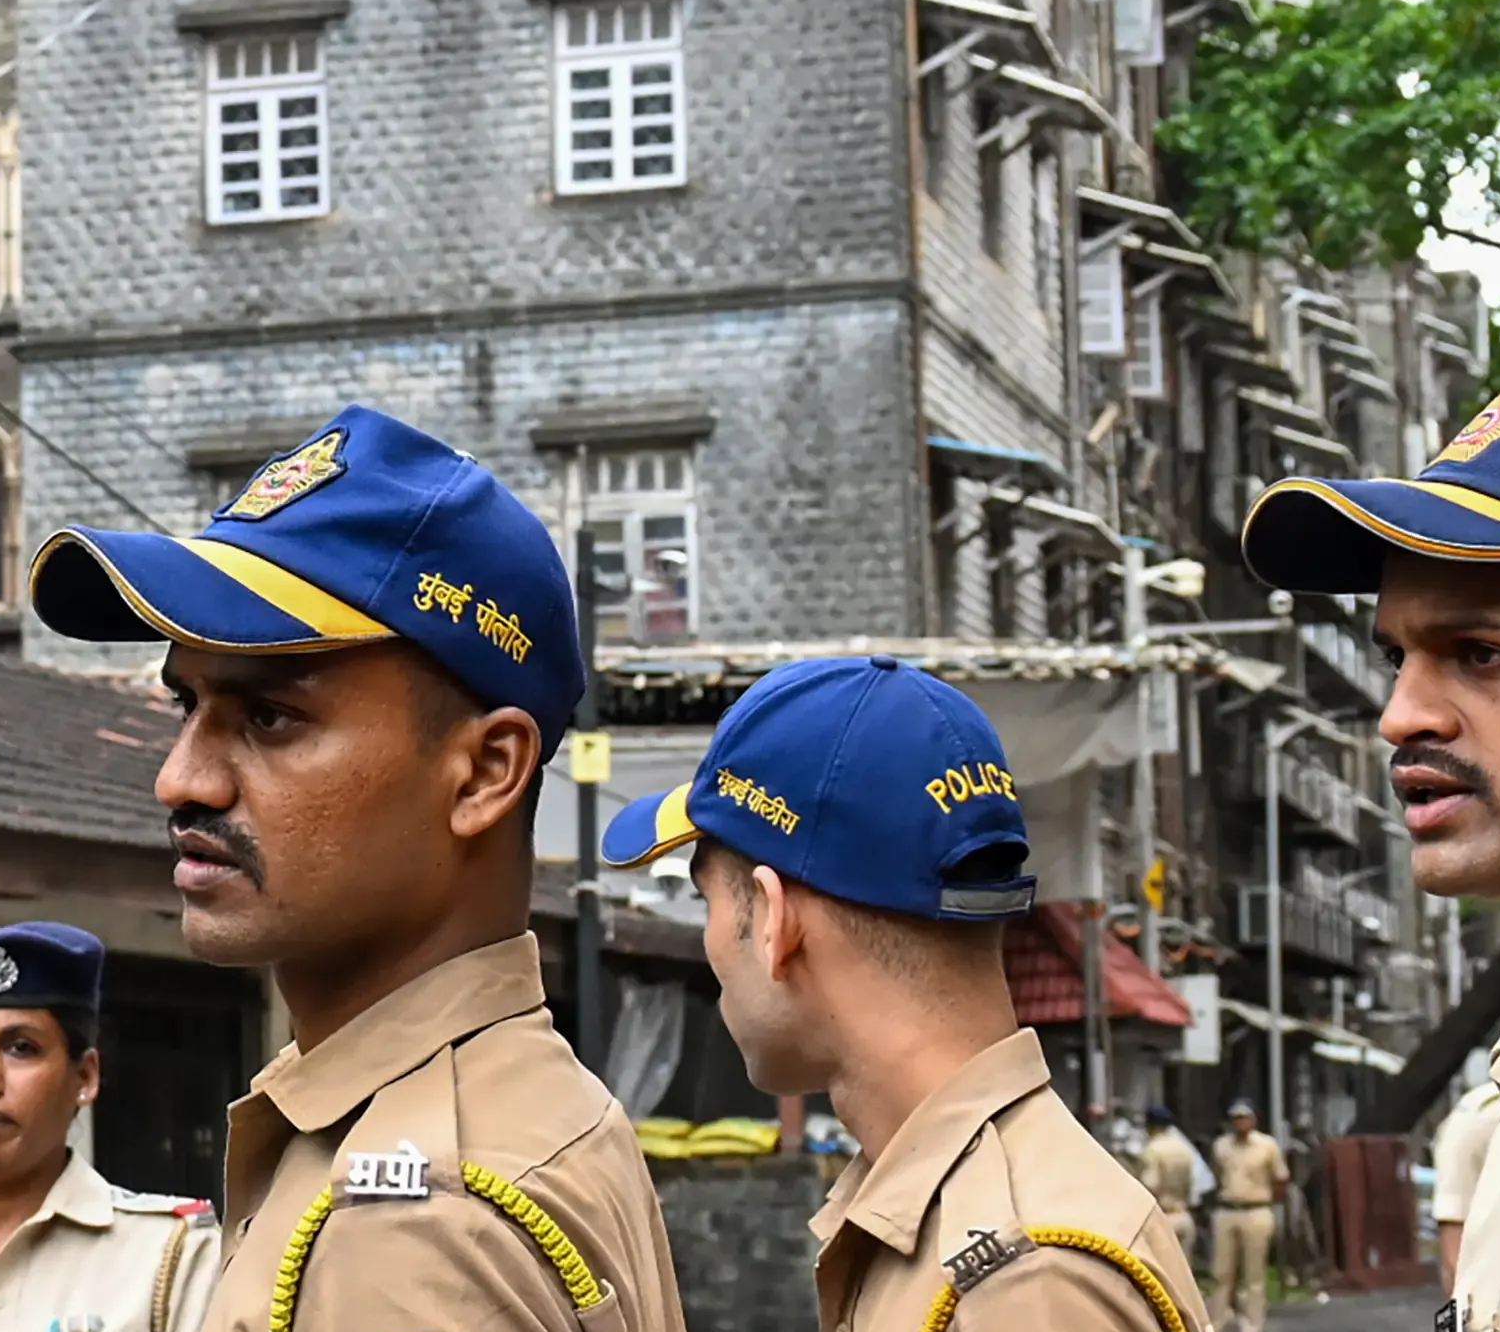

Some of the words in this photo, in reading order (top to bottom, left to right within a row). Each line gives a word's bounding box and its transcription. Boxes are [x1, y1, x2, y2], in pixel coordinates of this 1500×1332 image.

[413, 572, 474, 624] मुंबई
[475, 597, 534, 664] पोलीस
[716, 767, 754, 807] मुंबई
[746, 785, 801, 836] पोलीस
[924, 761, 1017, 815] POLICE
